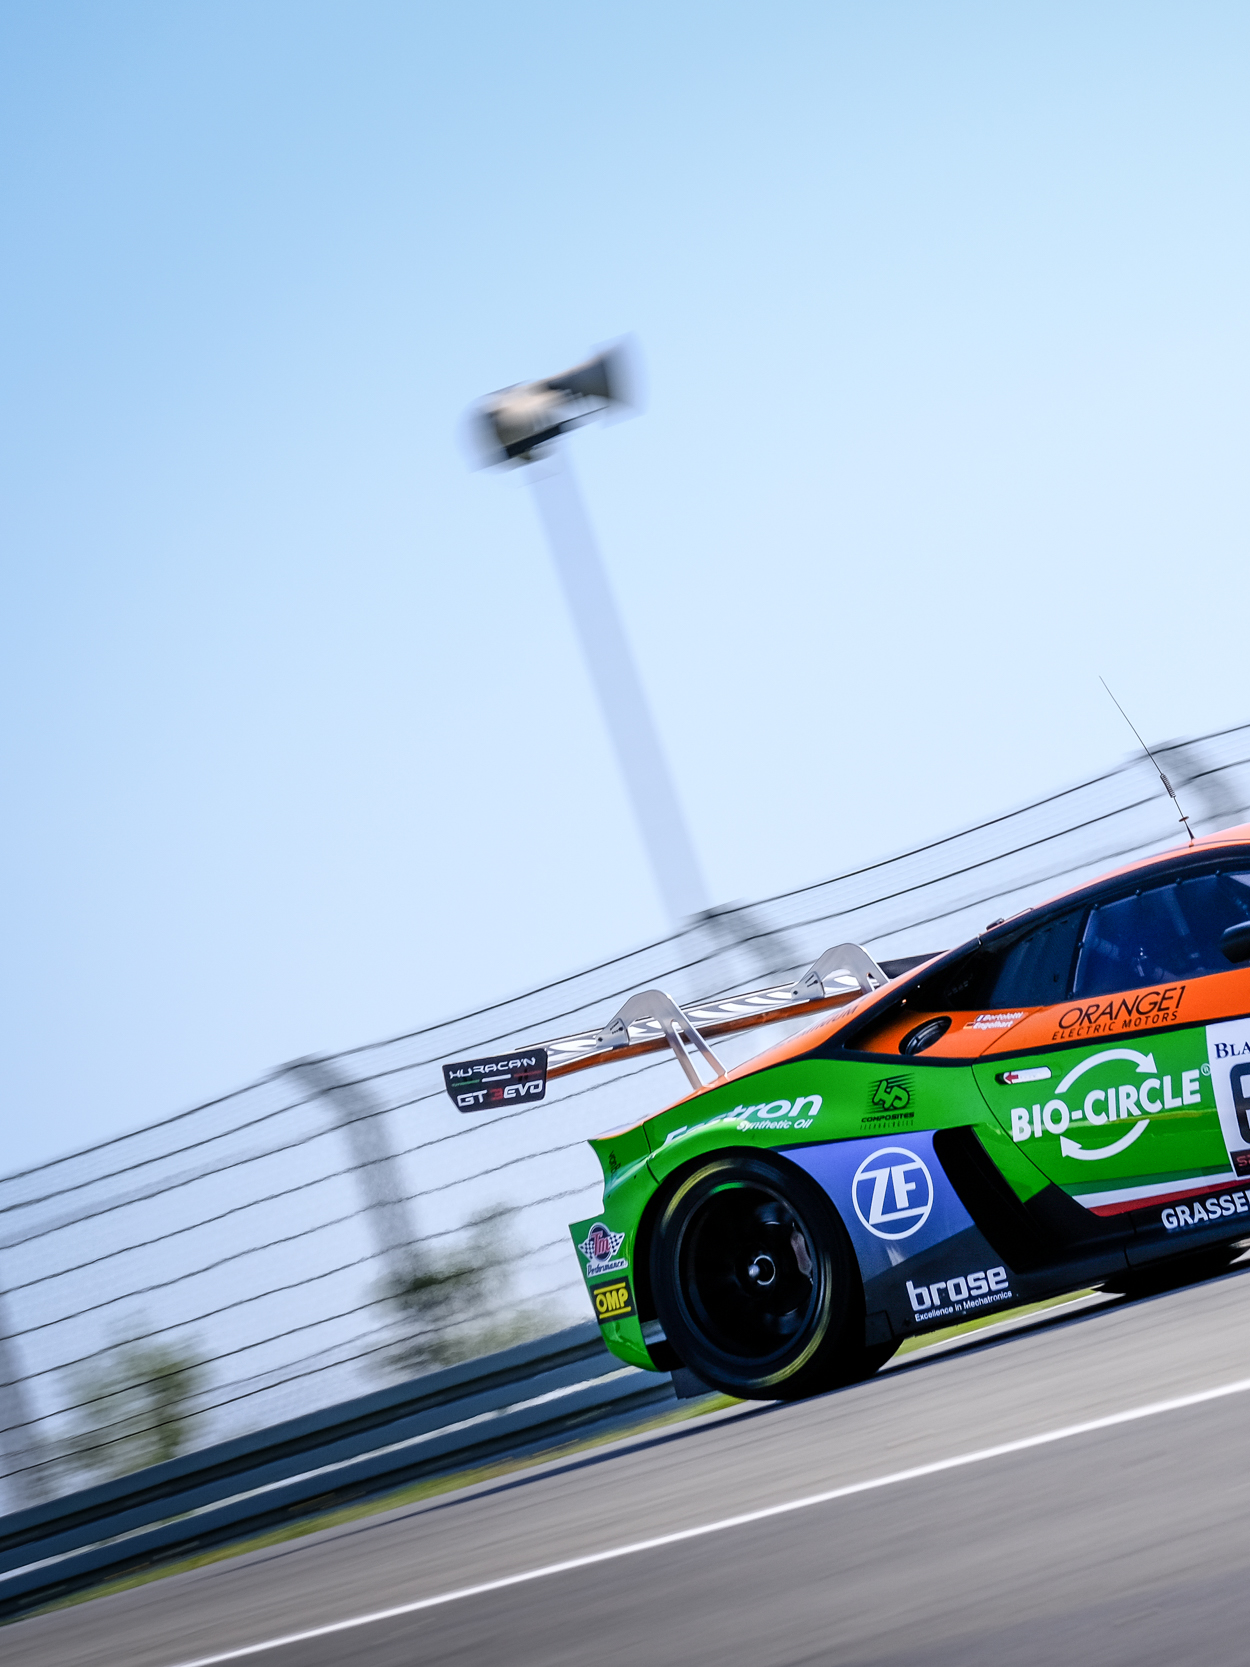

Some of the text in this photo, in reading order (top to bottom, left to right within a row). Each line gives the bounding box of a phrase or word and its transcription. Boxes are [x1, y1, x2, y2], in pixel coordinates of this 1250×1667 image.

[1051, 1010, 1179, 1041] ELECTRIC MOTORS
[1058, 985, 1187, 1030] ORANGE1
[736, 1117, 815, 1133] Synthetic Oil
[1010, 1068, 1202, 1143] BIO-CIRCLE
[855, 1159, 932, 1226] ZF
[595, 1287, 629, 1313] OMP
[905, 1265, 1009, 1312] brose
[914, 1306, 954, 1323] Excellence
[963, 1290, 1013, 1310] Mechatronics
